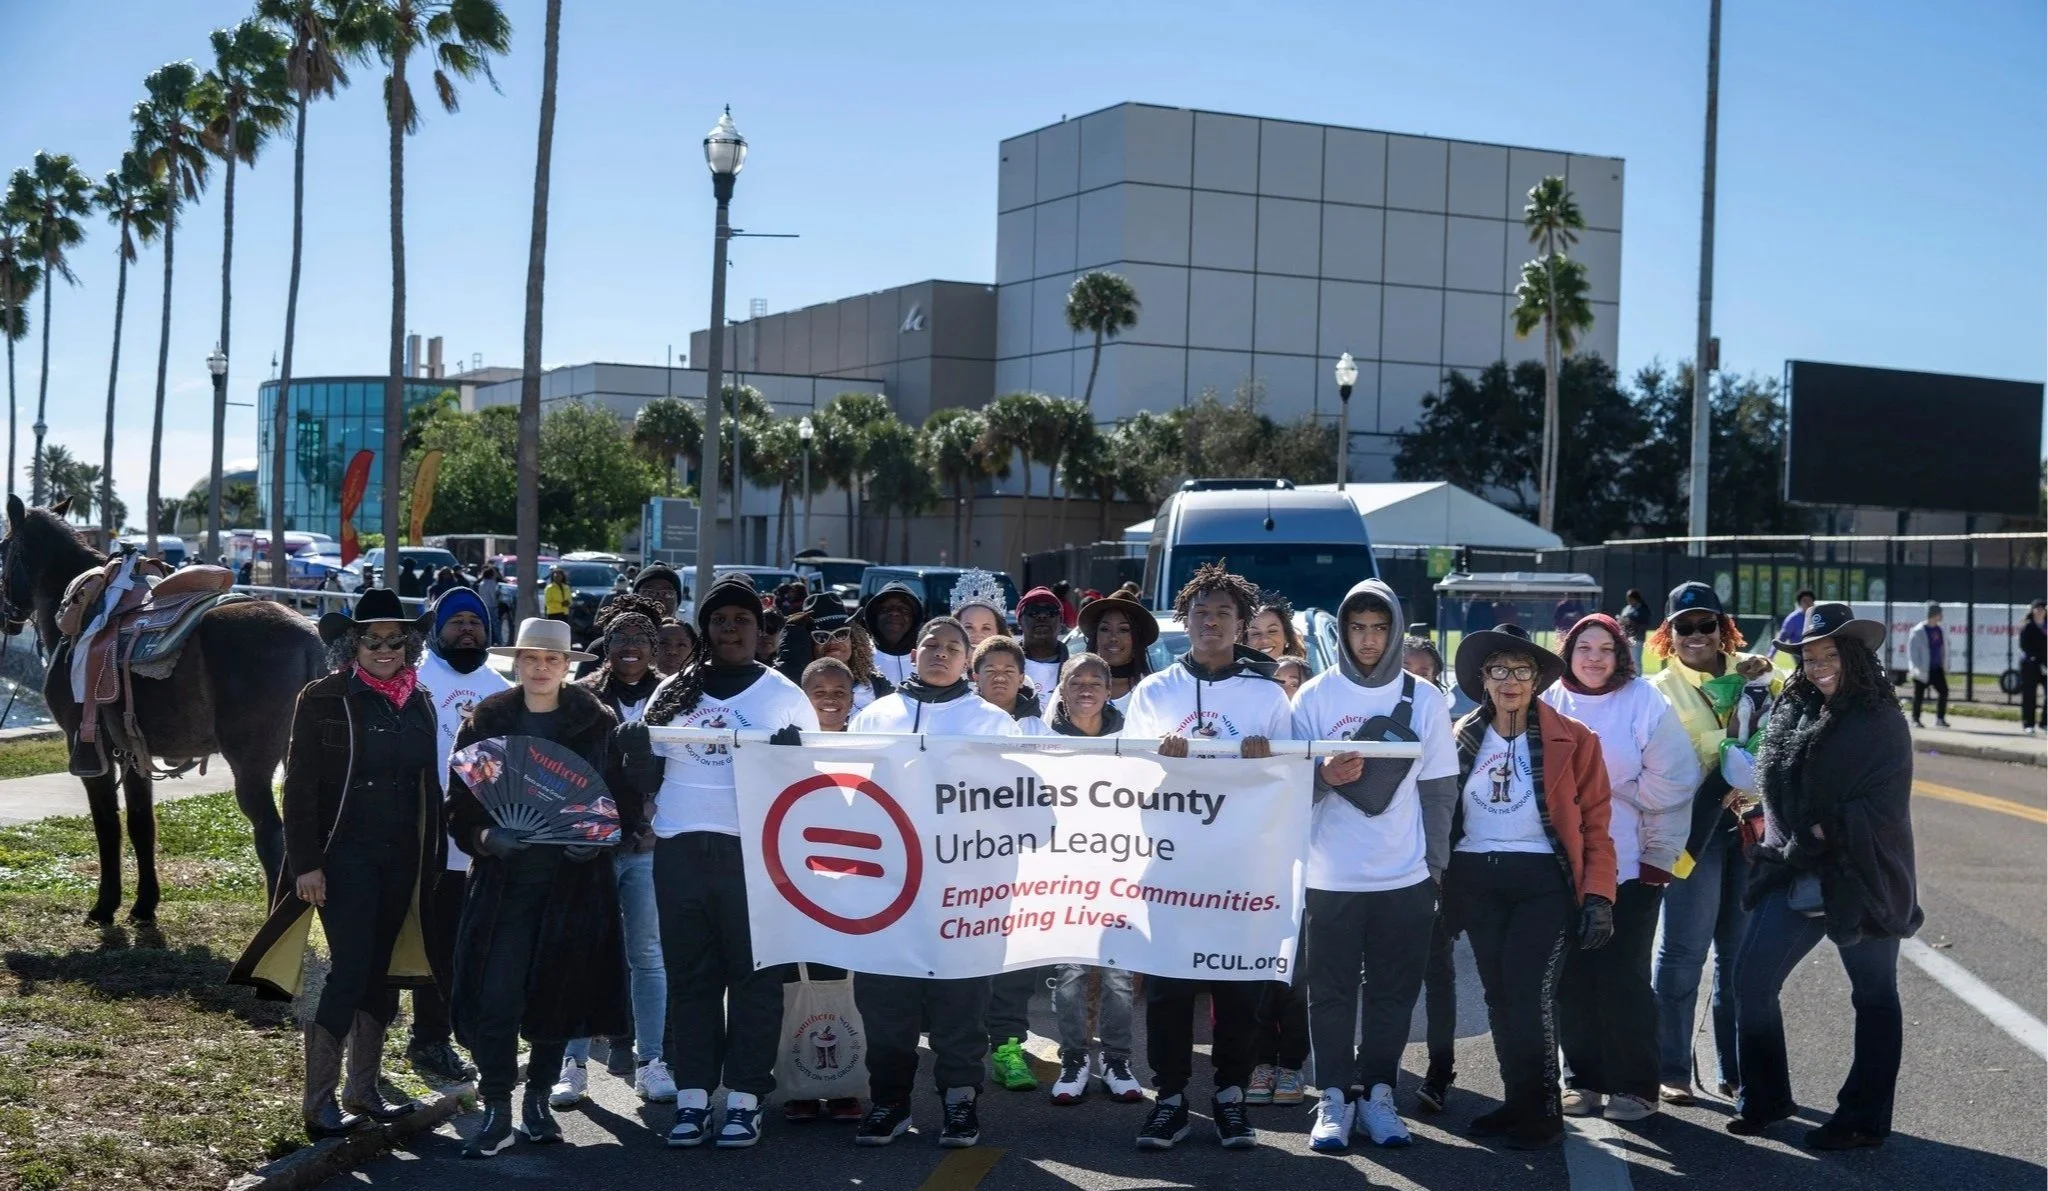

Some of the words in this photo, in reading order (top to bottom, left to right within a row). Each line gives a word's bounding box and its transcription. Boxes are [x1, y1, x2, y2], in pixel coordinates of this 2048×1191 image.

[441, 689, 477, 710] Southern
[682, 706, 730, 728] Southern
[734, 709, 752, 727] Soul
[1176, 710, 1219, 733] Southern
[1222, 714, 1240, 736] Soul
[441, 723, 456, 738] BOOT
[528, 744, 589, 788] Southern
[684, 743, 701, 762] BOOTS
[700, 758, 711, 766] ON
[711, 759, 725, 767] THE
[1518, 755, 1533, 776] Soul
[935, 776, 1078, 815] Pinellas
[1088, 780, 1226, 825] County
[1470, 790, 1487, 810] BOOTS
[1487, 806, 1498, 814] ON
[1510, 789, 1533, 812] GROUND
[935, 829, 1037, 864] Urban
[1050, 825, 1175, 863] League
[941, 875, 1100, 908] Empowering
[1109, 877, 1281, 912] Communities.
[939, 907, 1056, 939] Changing
[1063, 906, 1133, 930] Lives.
[1192, 952, 1289, 973] PCUL.org
[794, 1013, 836, 1038] Southern
[840, 1015, 859, 1037] Soul
[794, 1057, 813, 1077] BOOTS
[811, 1073, 822, 1081] ON
[837, 1053, 859, 1079] GROUND
